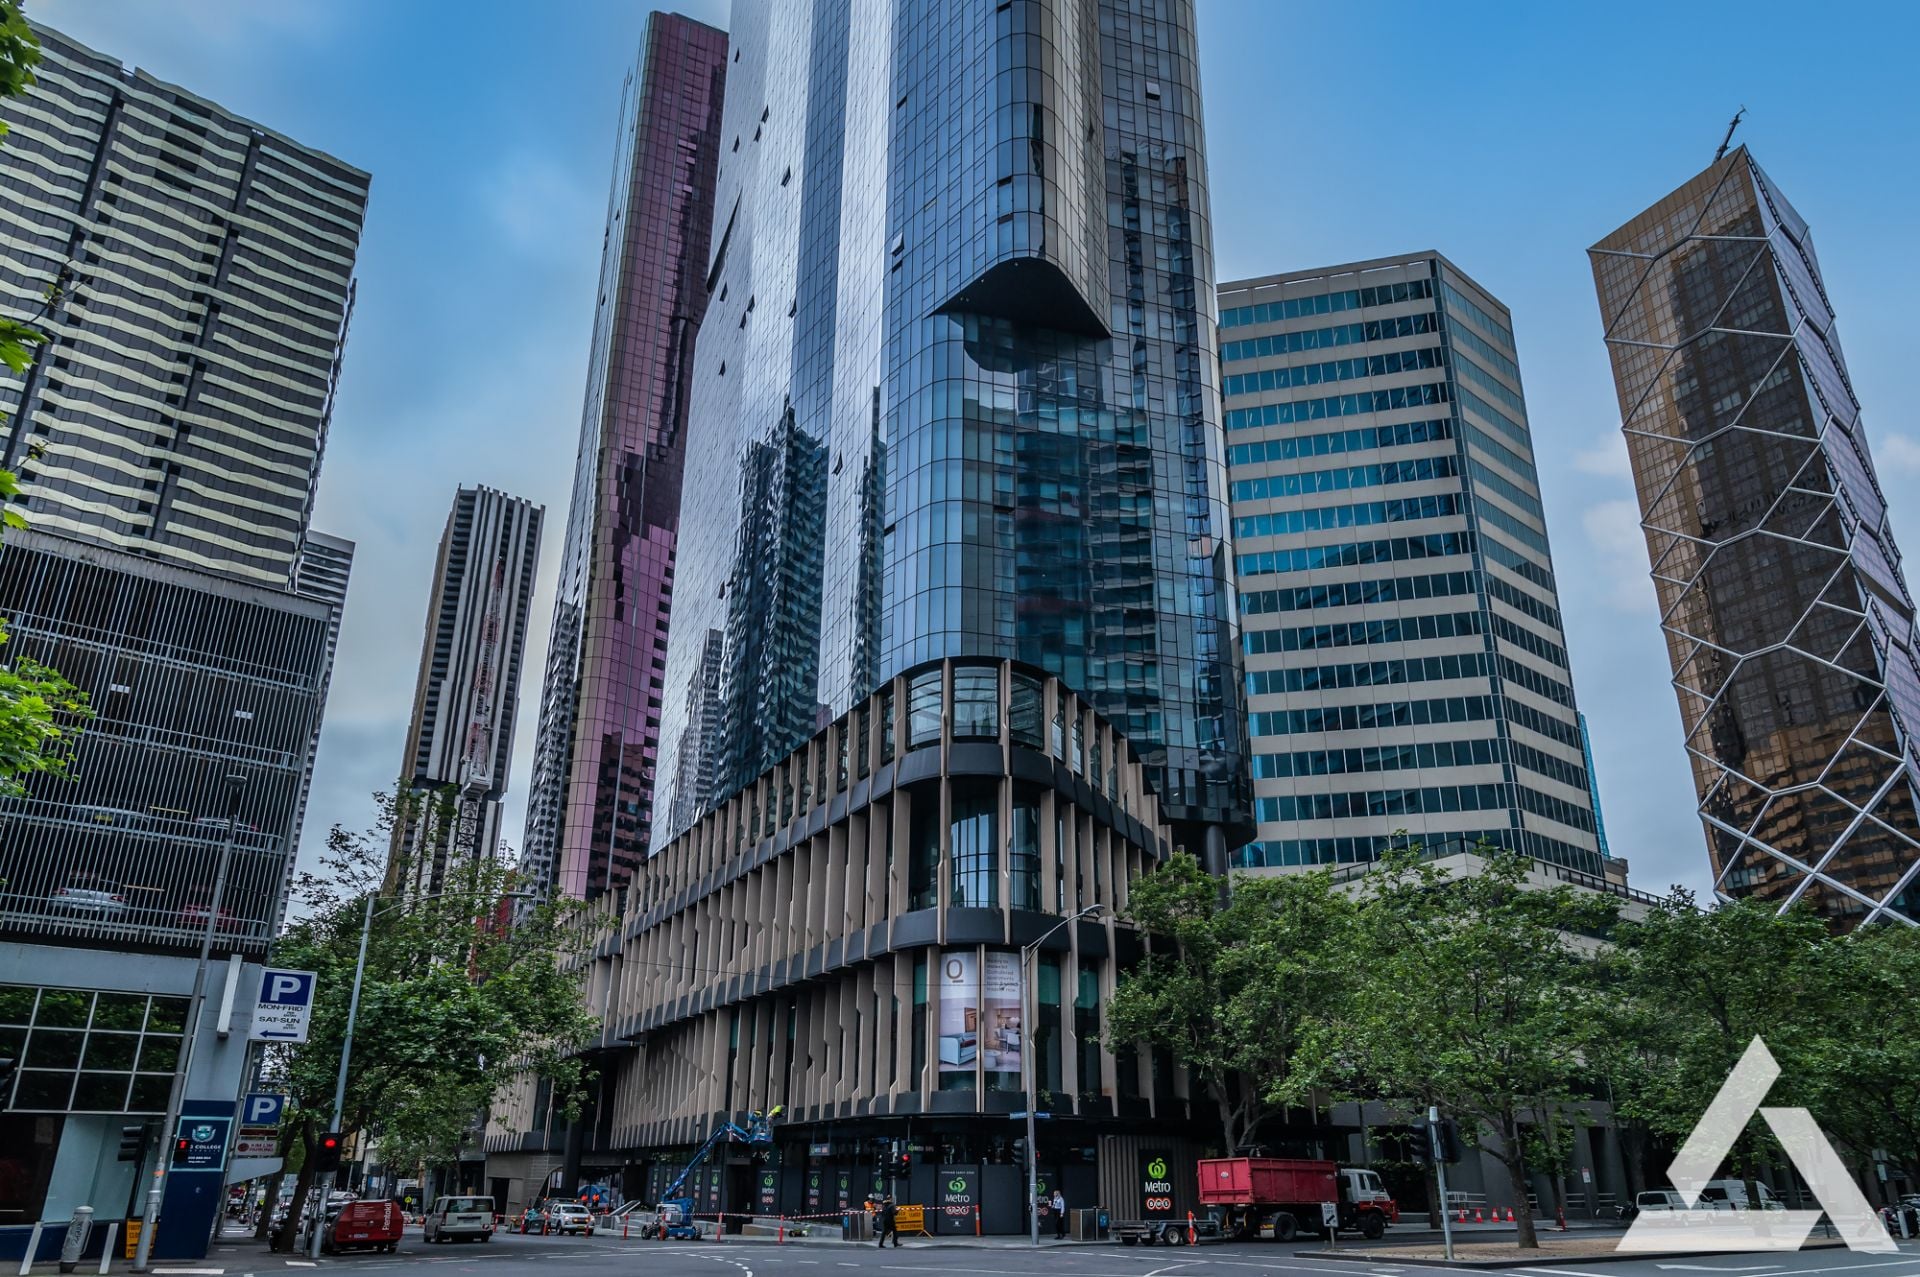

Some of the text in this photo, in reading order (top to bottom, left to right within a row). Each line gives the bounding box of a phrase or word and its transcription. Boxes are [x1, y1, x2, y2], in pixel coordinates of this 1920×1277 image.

[269, 975, 302, 1001] P
[258, 1016, 301, 1024] SAT-SUN
[250, 1097, 277, 1121] P
[1145, 1181, 1171, 1193] Metro
[945, 1193, 970, 1203] Metro
